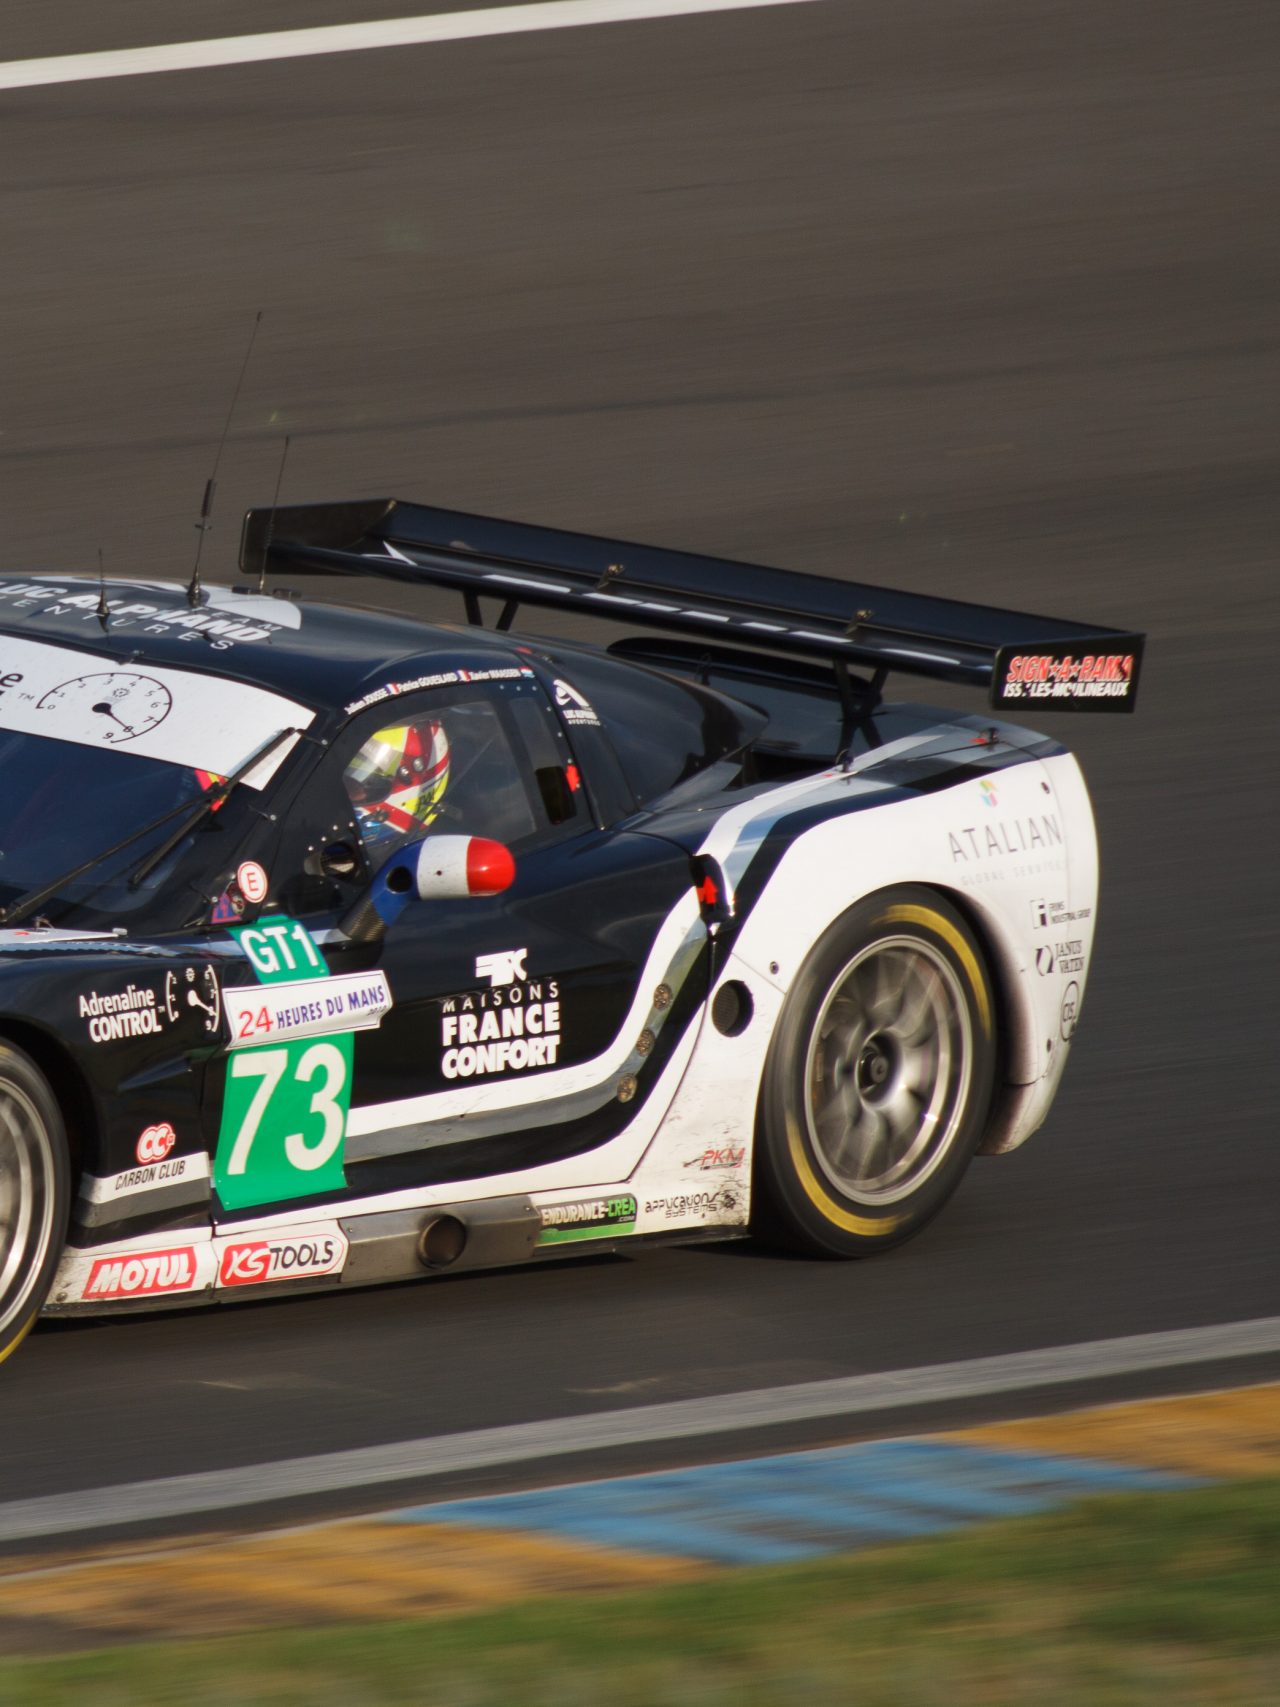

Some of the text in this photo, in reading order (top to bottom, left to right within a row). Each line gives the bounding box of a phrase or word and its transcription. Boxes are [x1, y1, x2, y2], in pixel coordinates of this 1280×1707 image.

[57, 594, 272, 642] ALPHAND
[947, 813, 1064, 863] ATALIAN
[246, 872, 259, 892] E
[240, 924, 319, 974] GT1
[80, 984, 156, 1018] Adrenaline
[238, 985, 385, 1039] 24 HEURES DU MANS
[442, 982, 559, 1013] MAISONS
[89, 1008, 163, 1043] CONTROL
[442, 1001, 560, 1047] FRANCE
[441, 1035, 561, 1079] CONFORT
[227, 1043, 347, 1176] 73
[115, 1160, 186, 1190] CARBON CLUB
[89, 1252, 192, 1293] MOTUL
[224, 1240, 333, 1280] KS TOOLS
